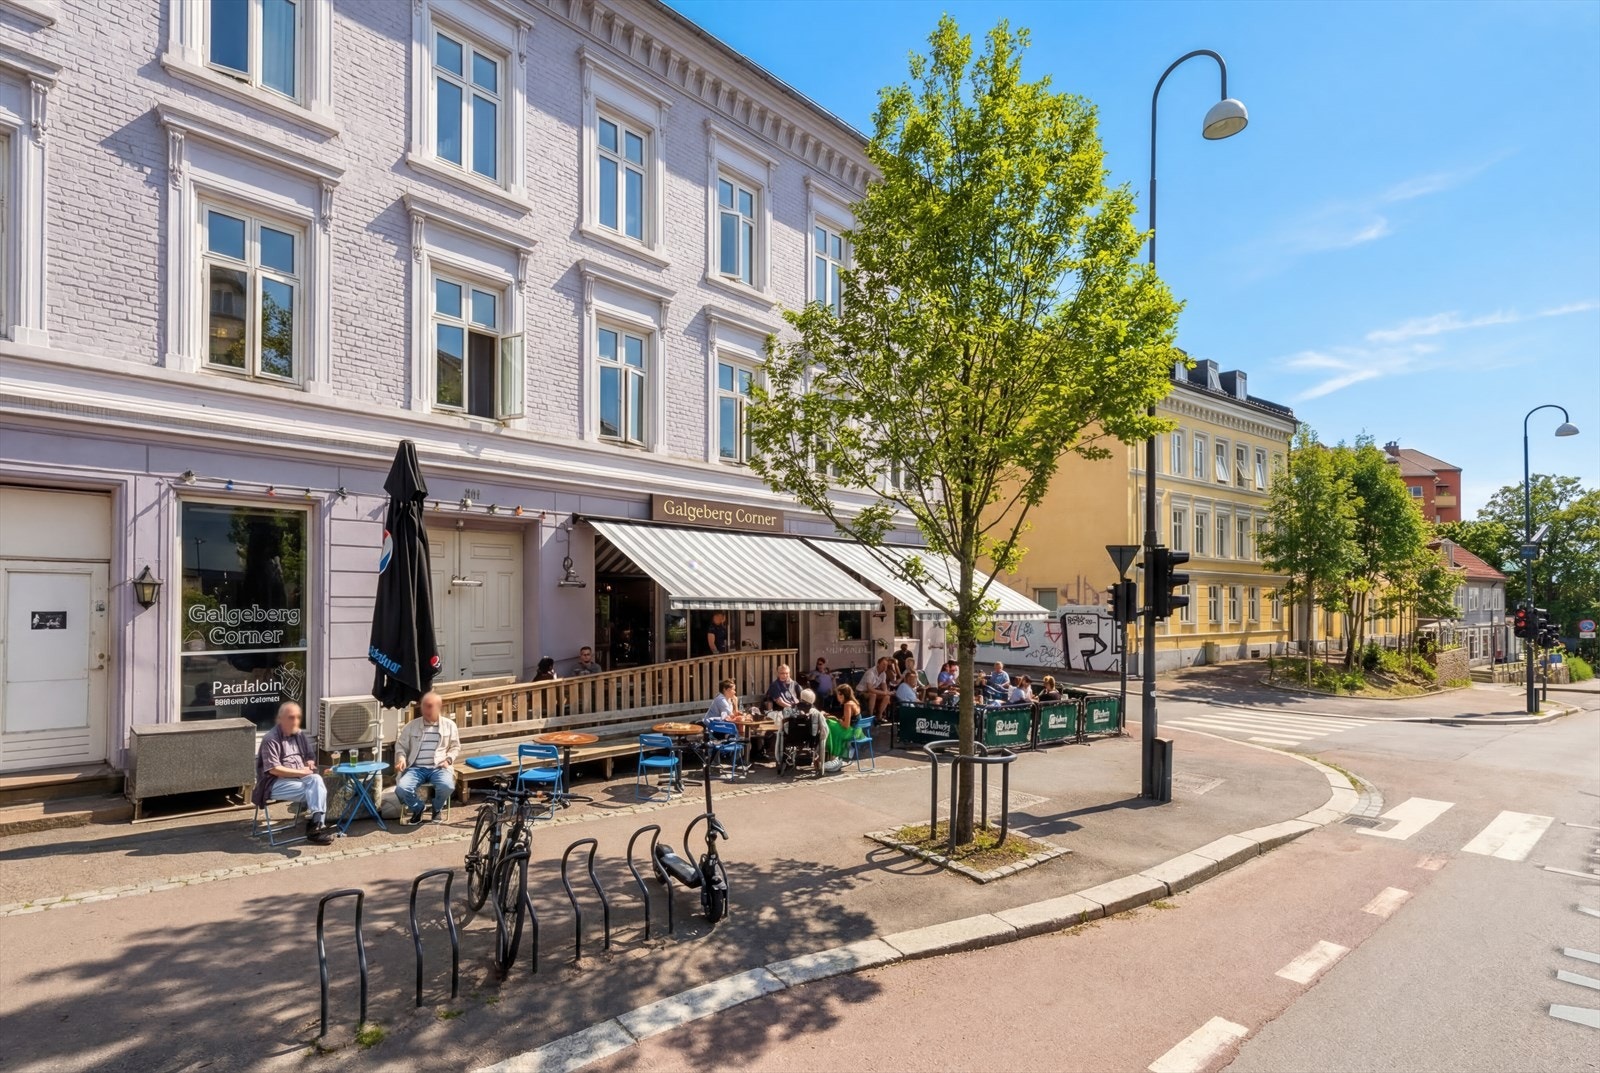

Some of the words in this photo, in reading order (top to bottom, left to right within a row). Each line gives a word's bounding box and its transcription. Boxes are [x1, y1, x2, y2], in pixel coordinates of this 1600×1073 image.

[663, 500, 733, 525] Galgeberg
[735, 509, 777, 526] Corner
[188, 604, 301, 627] Galgeberg
[209, 626, 284, 645] Corner
